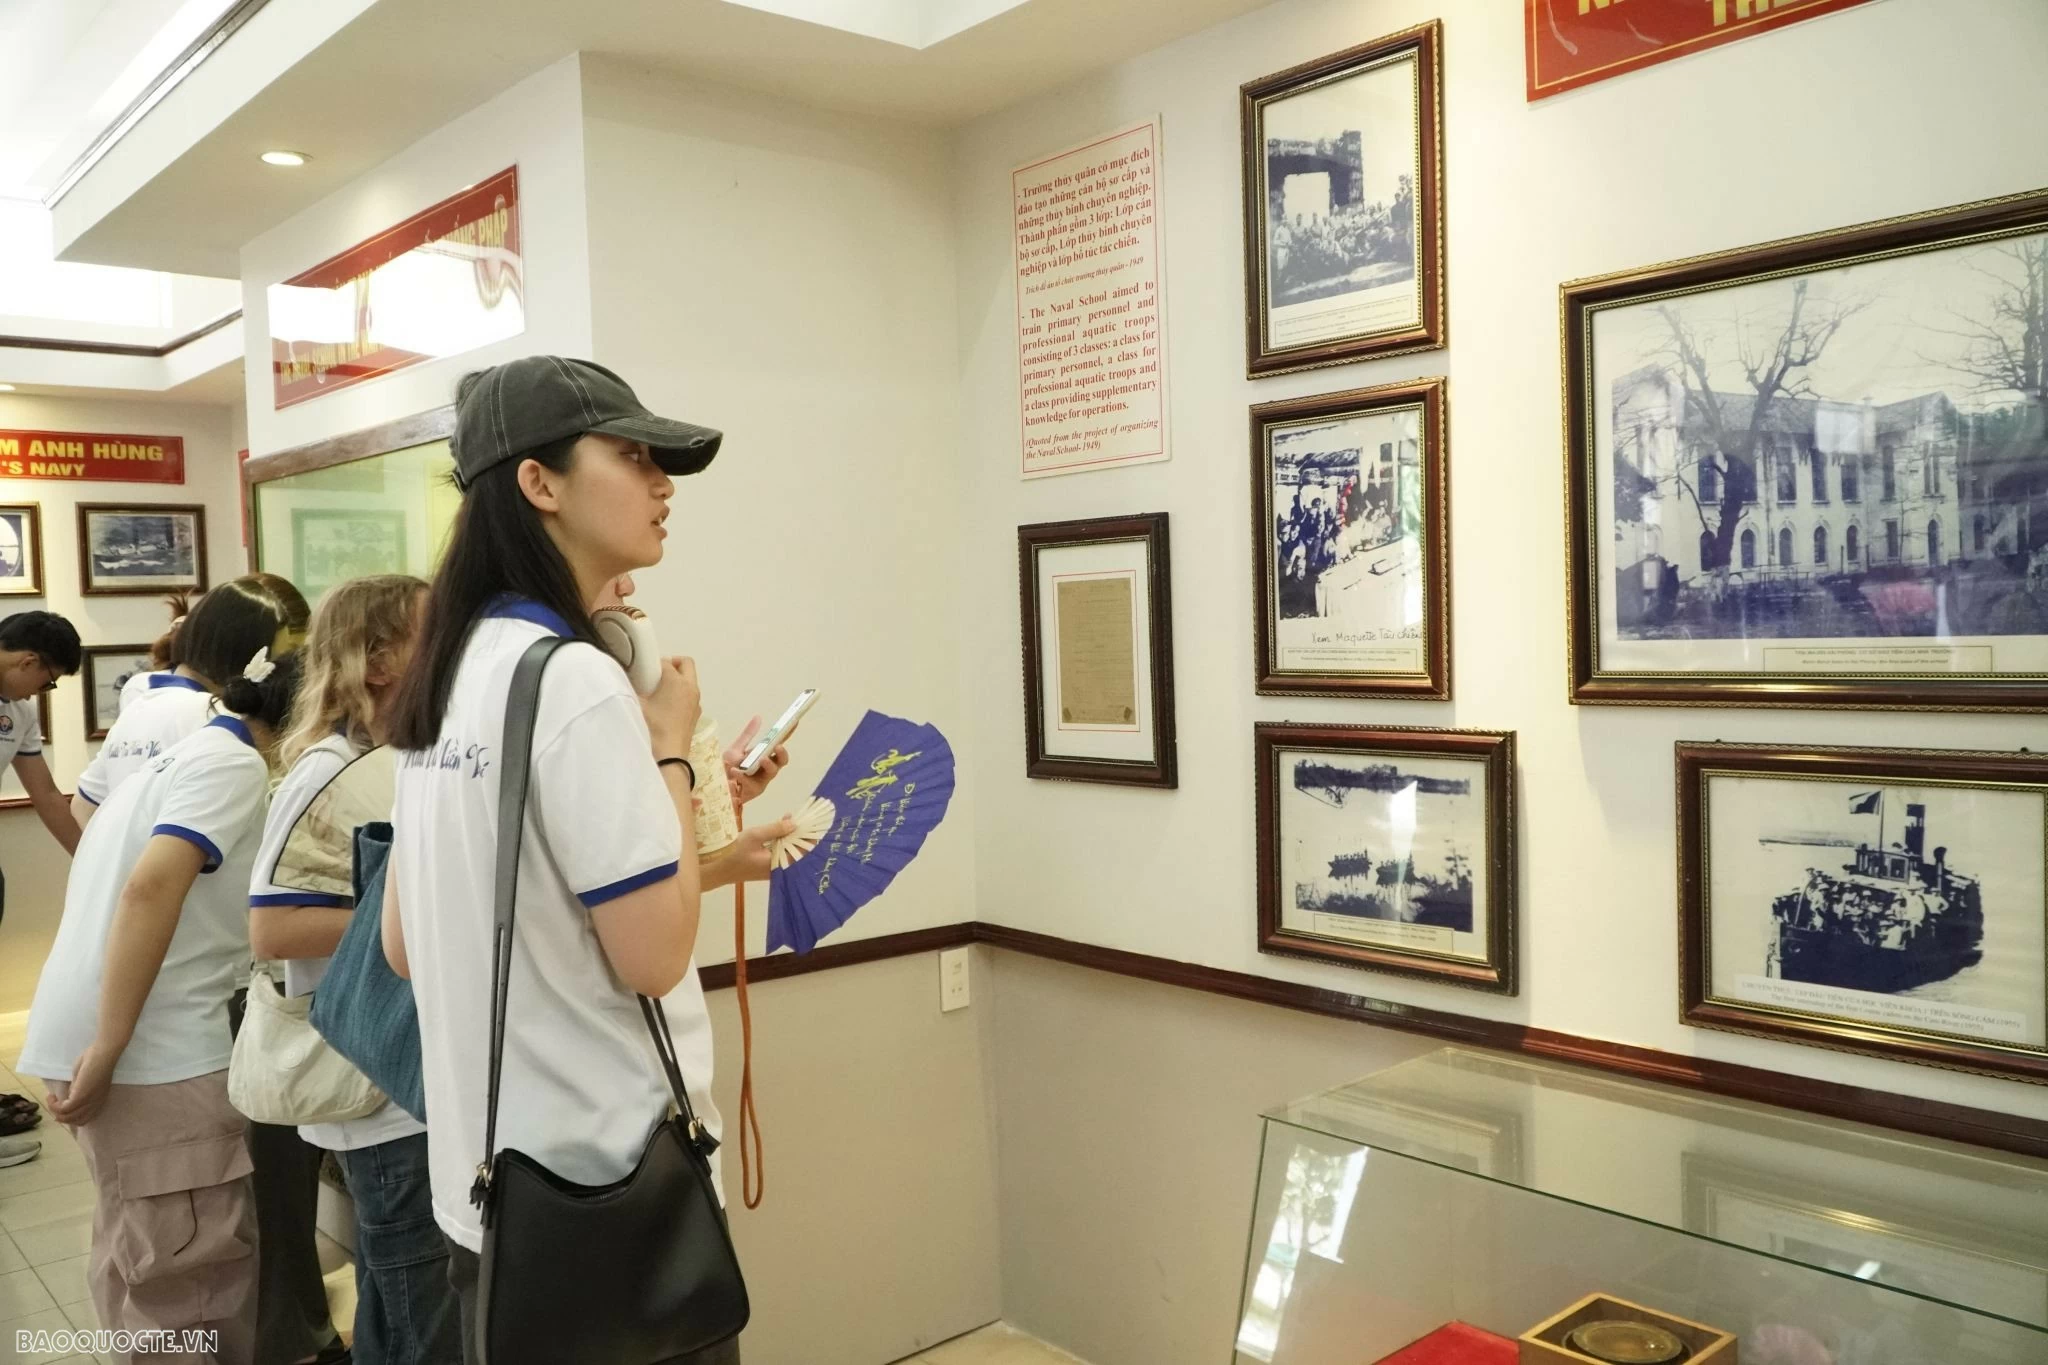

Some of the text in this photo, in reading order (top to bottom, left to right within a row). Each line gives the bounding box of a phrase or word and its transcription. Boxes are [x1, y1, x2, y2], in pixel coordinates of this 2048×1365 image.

[1109, 156, 1128, 169] mục
[1034, 199, 1047, 211] tạo
[1065, 201, 1084, 215] binh
[1086, 191, 1116, 209] chuyên
[1098, 223, 1118, 237] binh
[1030, 307, 1044, 318] The
[1050, 298, 1073, 313] Naval
[1078, 290, 1106, 306] School
[1112, 281, 1138, 298] aimed
[1022, 295, 1154, 336] train primary personnel and
[1022, 314, 1154, 353] professional aquatic troops
[1023, 350, 1062, 366] consisting
[1079, 340, 1110, 354] classes:
[1119, 334, 1140, 345] class
[1142, 329, 1155, 340] for
[1023, 368, 1055, 384] primary
[1060, 355, 1103, 376] personnel,
[1117, 350, 1137, 362] class
[1142, 345, 1156, 357] for
[1024, 360, 1156, 399] professional aquatic troops and
[1030, 399, 1049, 410] class
[1050, 391, 1090, 409] providing
[1091, 380, 1155, 400] supplementary
[1025, 401, 1128, 426] knowledge for operations.
[1053, 433, 1069, 445] from
[1071, 430, 1082, 440] the
[1084, 426, 1107, 440] project
[1119, 418, 1158, 433] organizing
[28, 440, 85, 458] ANH
[92, 440, 164, 461] HÙNG
[1025, 450, 1035, 459] the
[1036, 446, 1056, 458] Naval
[30, 461, 86, 476] NAVY
